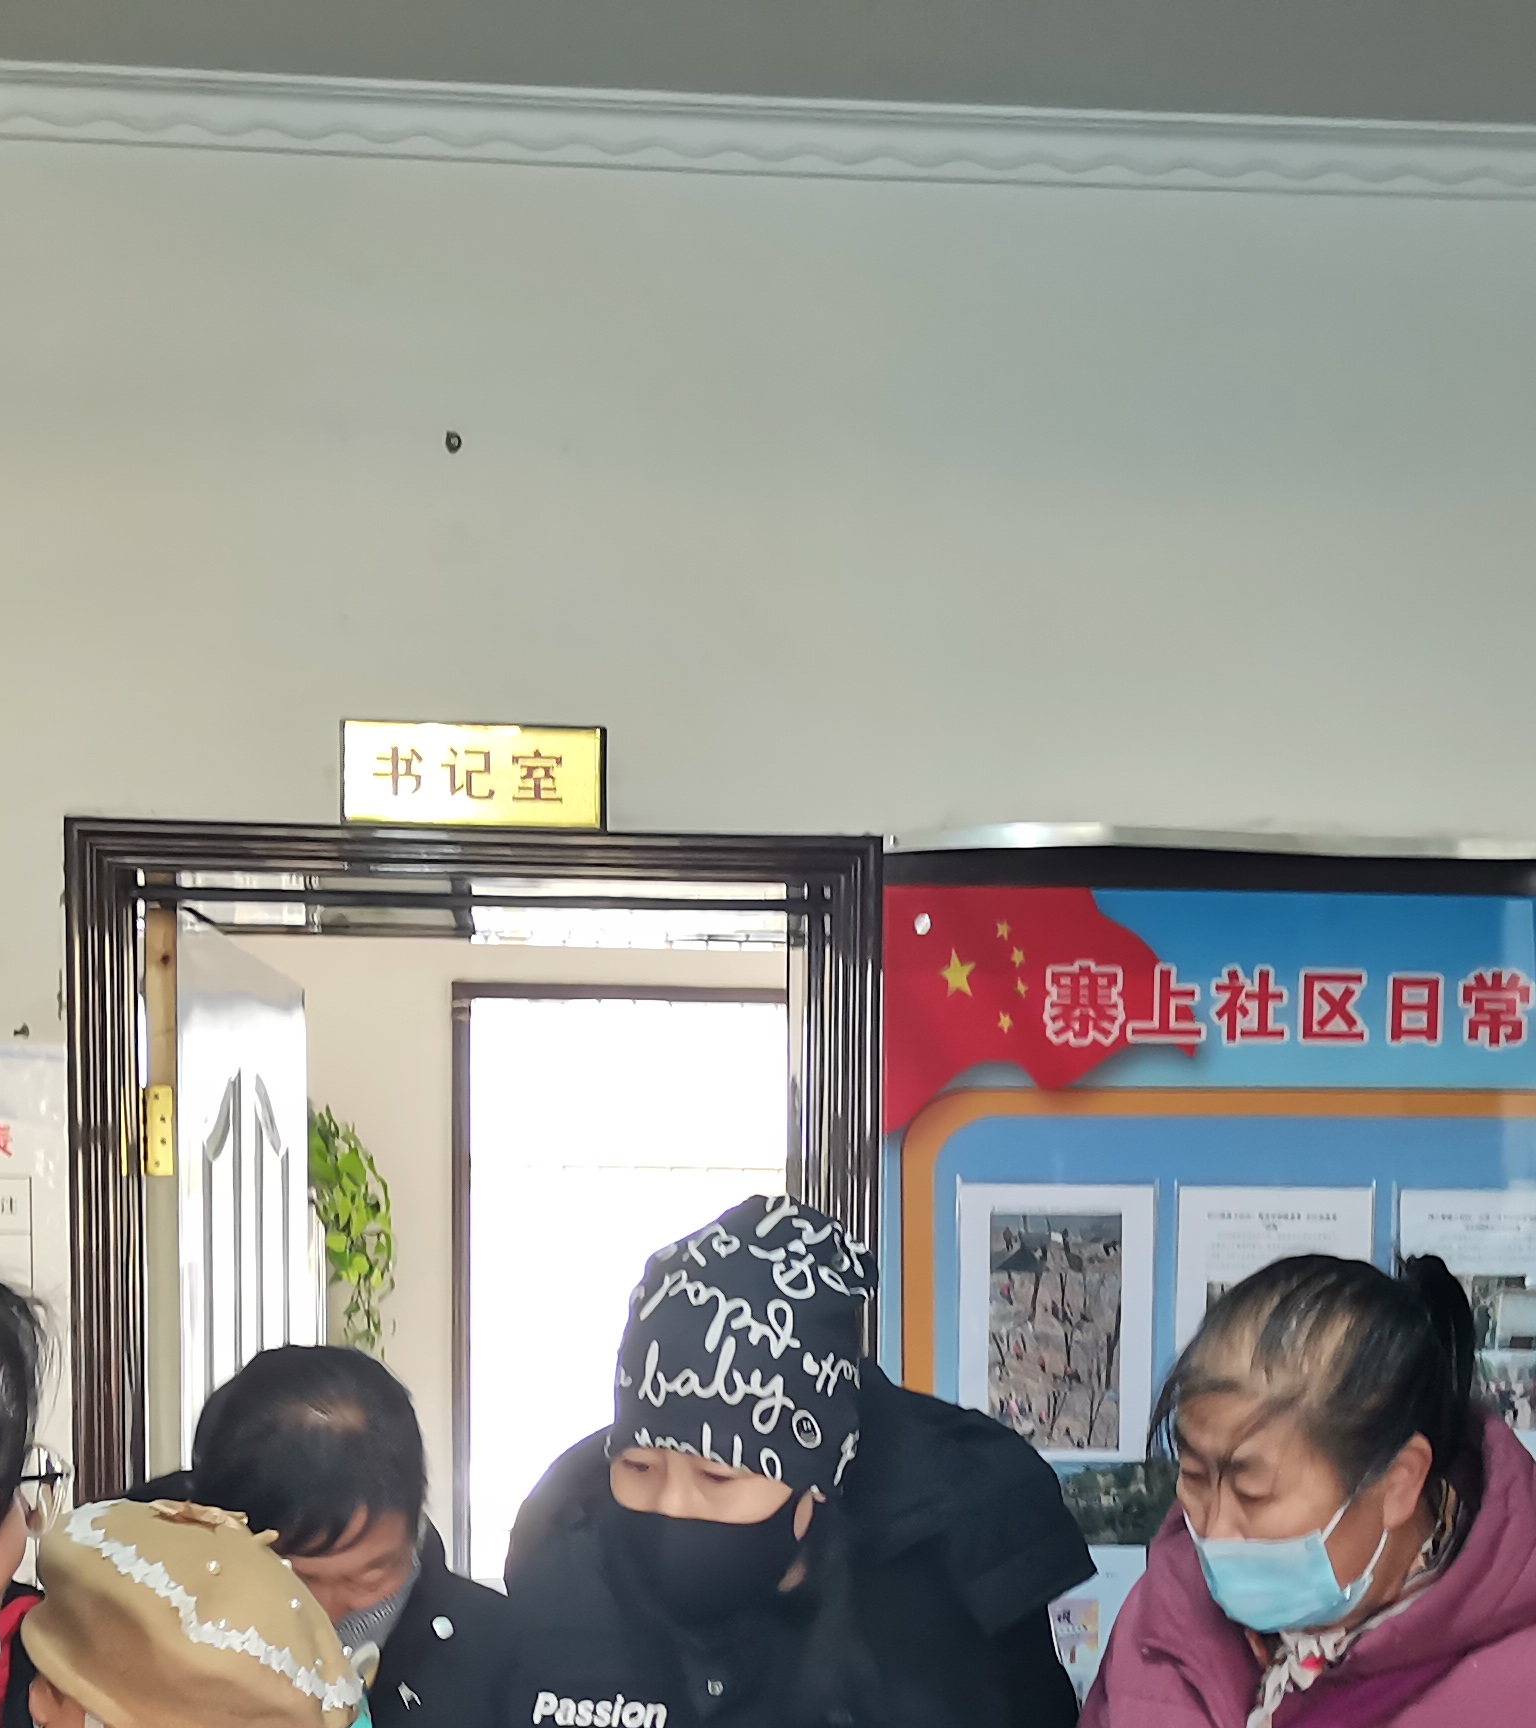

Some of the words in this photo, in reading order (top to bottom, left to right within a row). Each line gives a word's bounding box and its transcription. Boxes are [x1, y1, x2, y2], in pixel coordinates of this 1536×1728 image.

[372, 745, 564, 804] 书记室
[637, 1339, 796, 1435] baby
